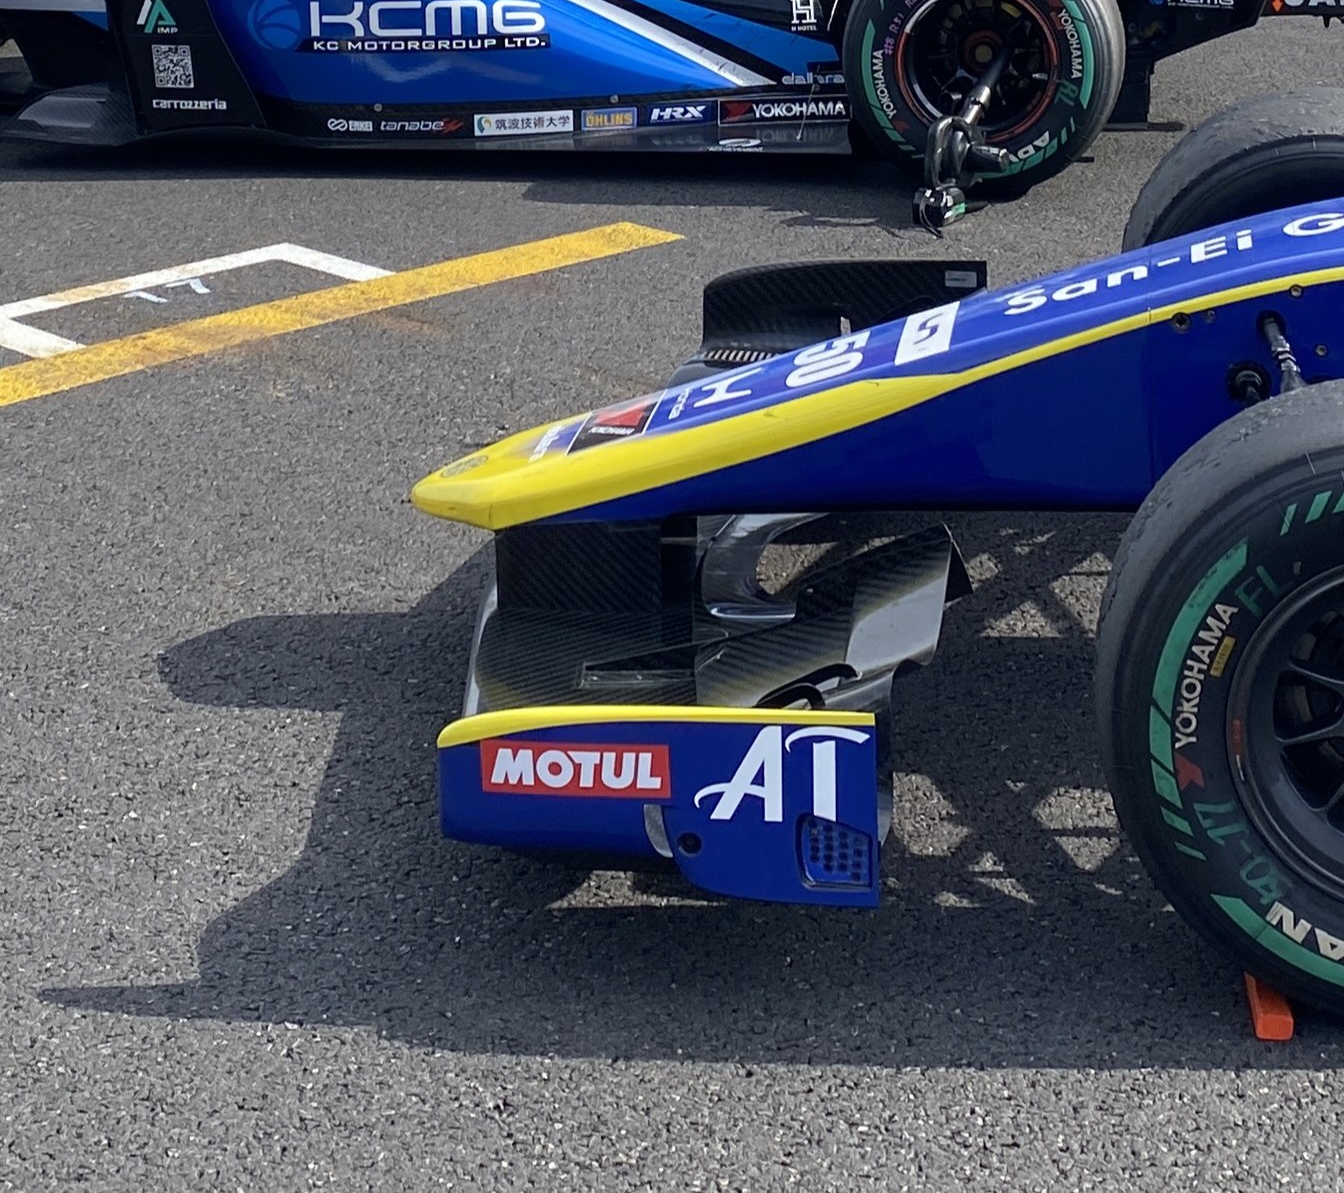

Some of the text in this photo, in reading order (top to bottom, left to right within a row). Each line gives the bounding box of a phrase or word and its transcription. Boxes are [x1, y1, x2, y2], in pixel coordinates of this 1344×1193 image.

[157, 26, 178, 34] IMP
[313, 36, 547, 50] KC MOTORGROUP LTD.
[1058, 8, 1083, 79] YOKOHAMA
[872, 49, 898, 119] YOKOHAMA
[152, 98, 228, 110] carrozzeria
[752, 101, 847, 119] YOKOHAMA
[494, 114, 571, 132] 筑波技術大学
[650, 107, 707, 123] HRX
[380, 119, 446, 131] tanabe
[1003, 229, 1253, 318] San-Ei
[1174, 601, 1239, 751] YOKOHAMA
[489, 747, 663, 790] MOTUL
